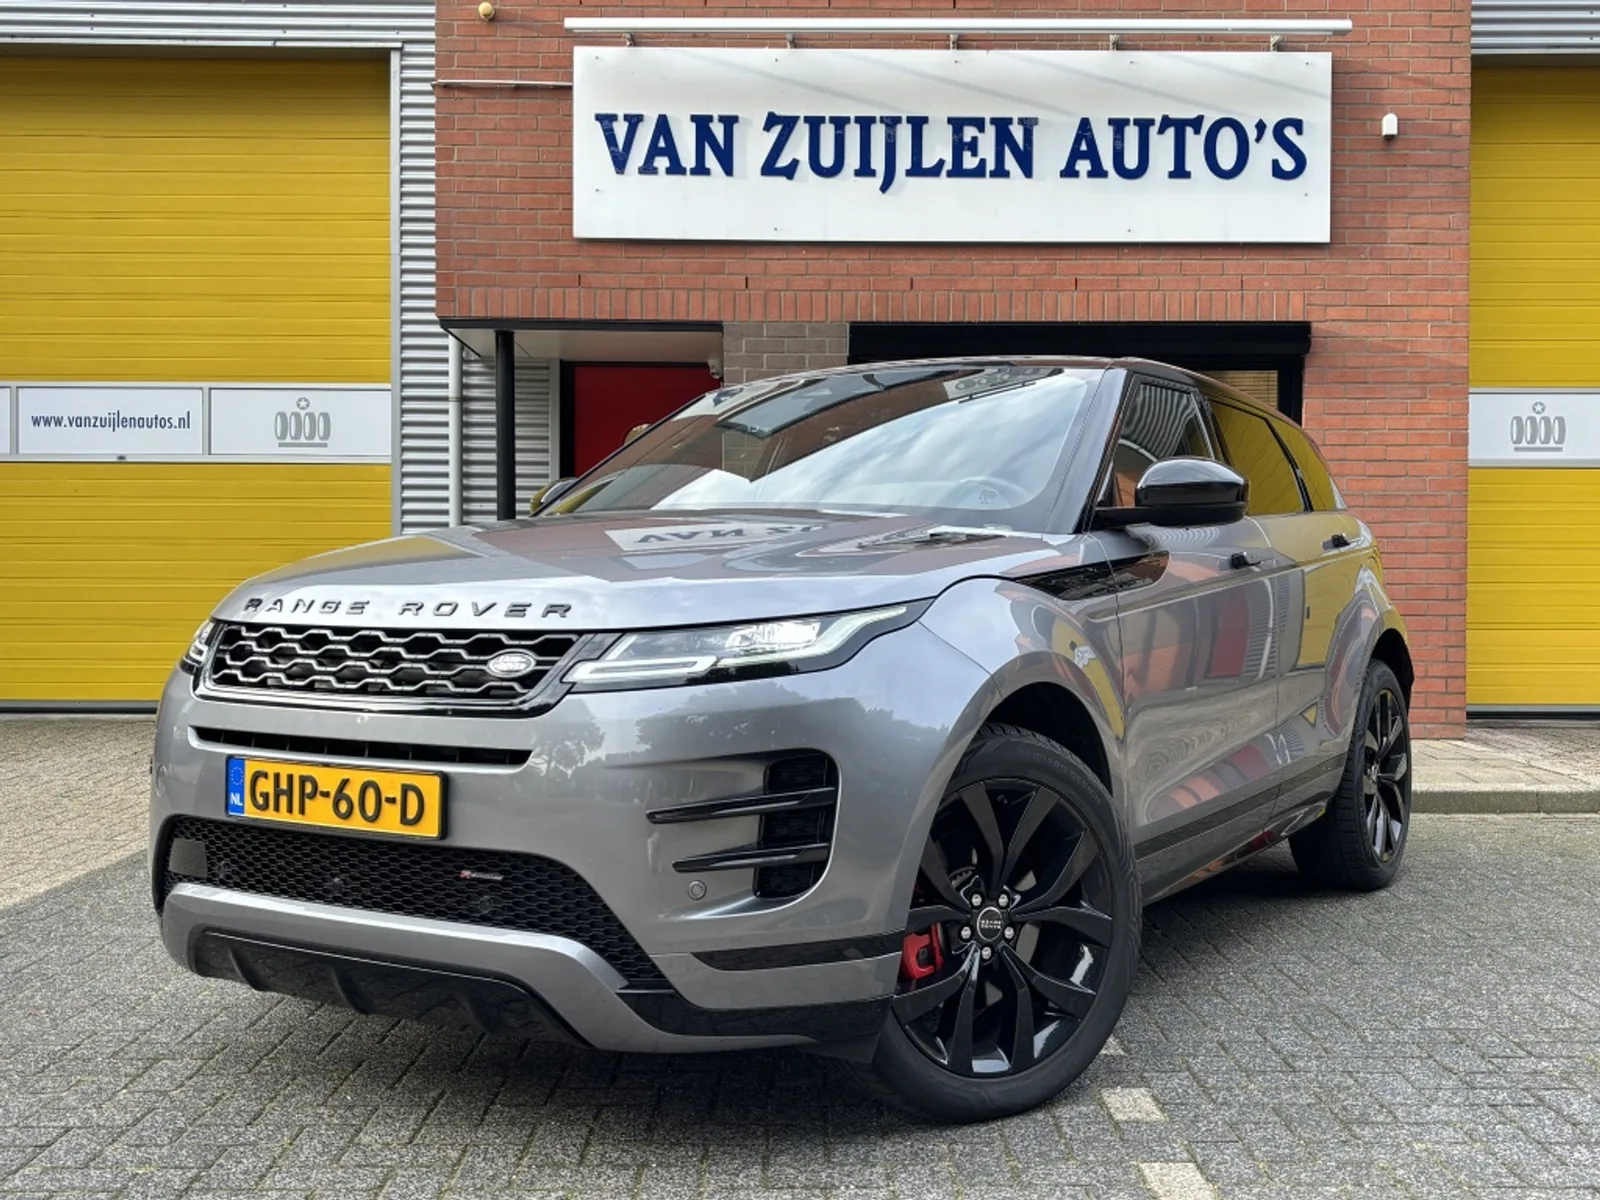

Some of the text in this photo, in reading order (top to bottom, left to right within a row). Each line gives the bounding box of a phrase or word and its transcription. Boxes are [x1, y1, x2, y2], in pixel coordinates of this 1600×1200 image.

[594, 111, 1308, 194] VAN ZUIJLEN AUTO'S
[31, 410, 190, 432] www.vanzuijlenautos.nl
[242, 598, 573, 618] RANGE ROVER
[230, 792, 243, 806] NL
[250, 769, 425, 827] GHP-60-D
